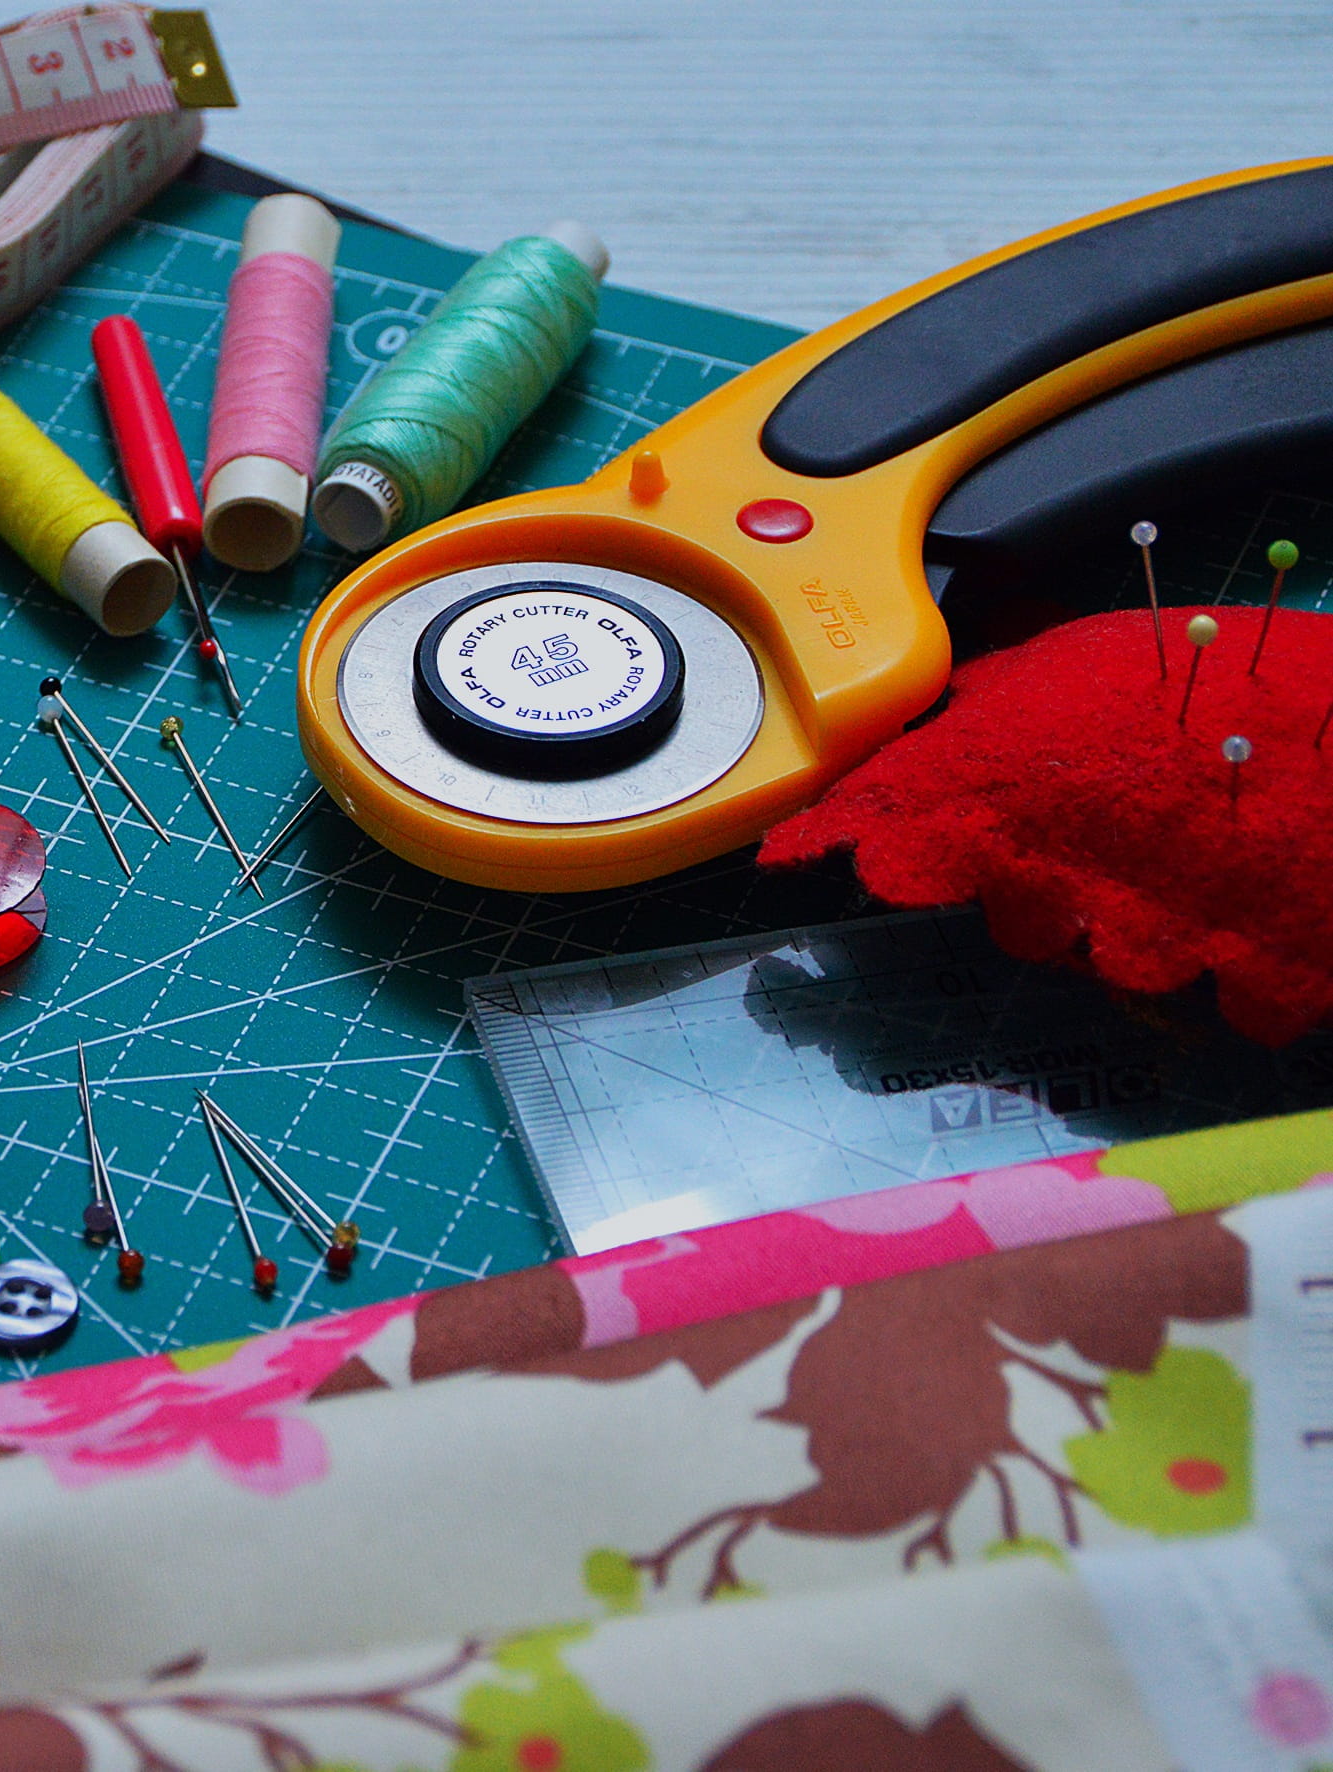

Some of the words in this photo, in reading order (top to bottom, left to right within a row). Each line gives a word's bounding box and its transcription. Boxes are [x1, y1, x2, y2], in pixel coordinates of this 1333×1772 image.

[28, 51, 64, 75] 3
[102, 37, 135, 61] 2
[513, 605, 589, 620] CUTTER
[799, 576, 856, 650] OLFA
[459, 613, 507, 658] ROTARY
[510, 633, 579, 671] 45
[597, 618, 642, 660] OLFA
[461, 667, 506, 709] OLFA
[528, 658, 589, 687] mm
[599, 666, 644, 713] ROTARY
[516, 707, 593, 721] CUTTER
